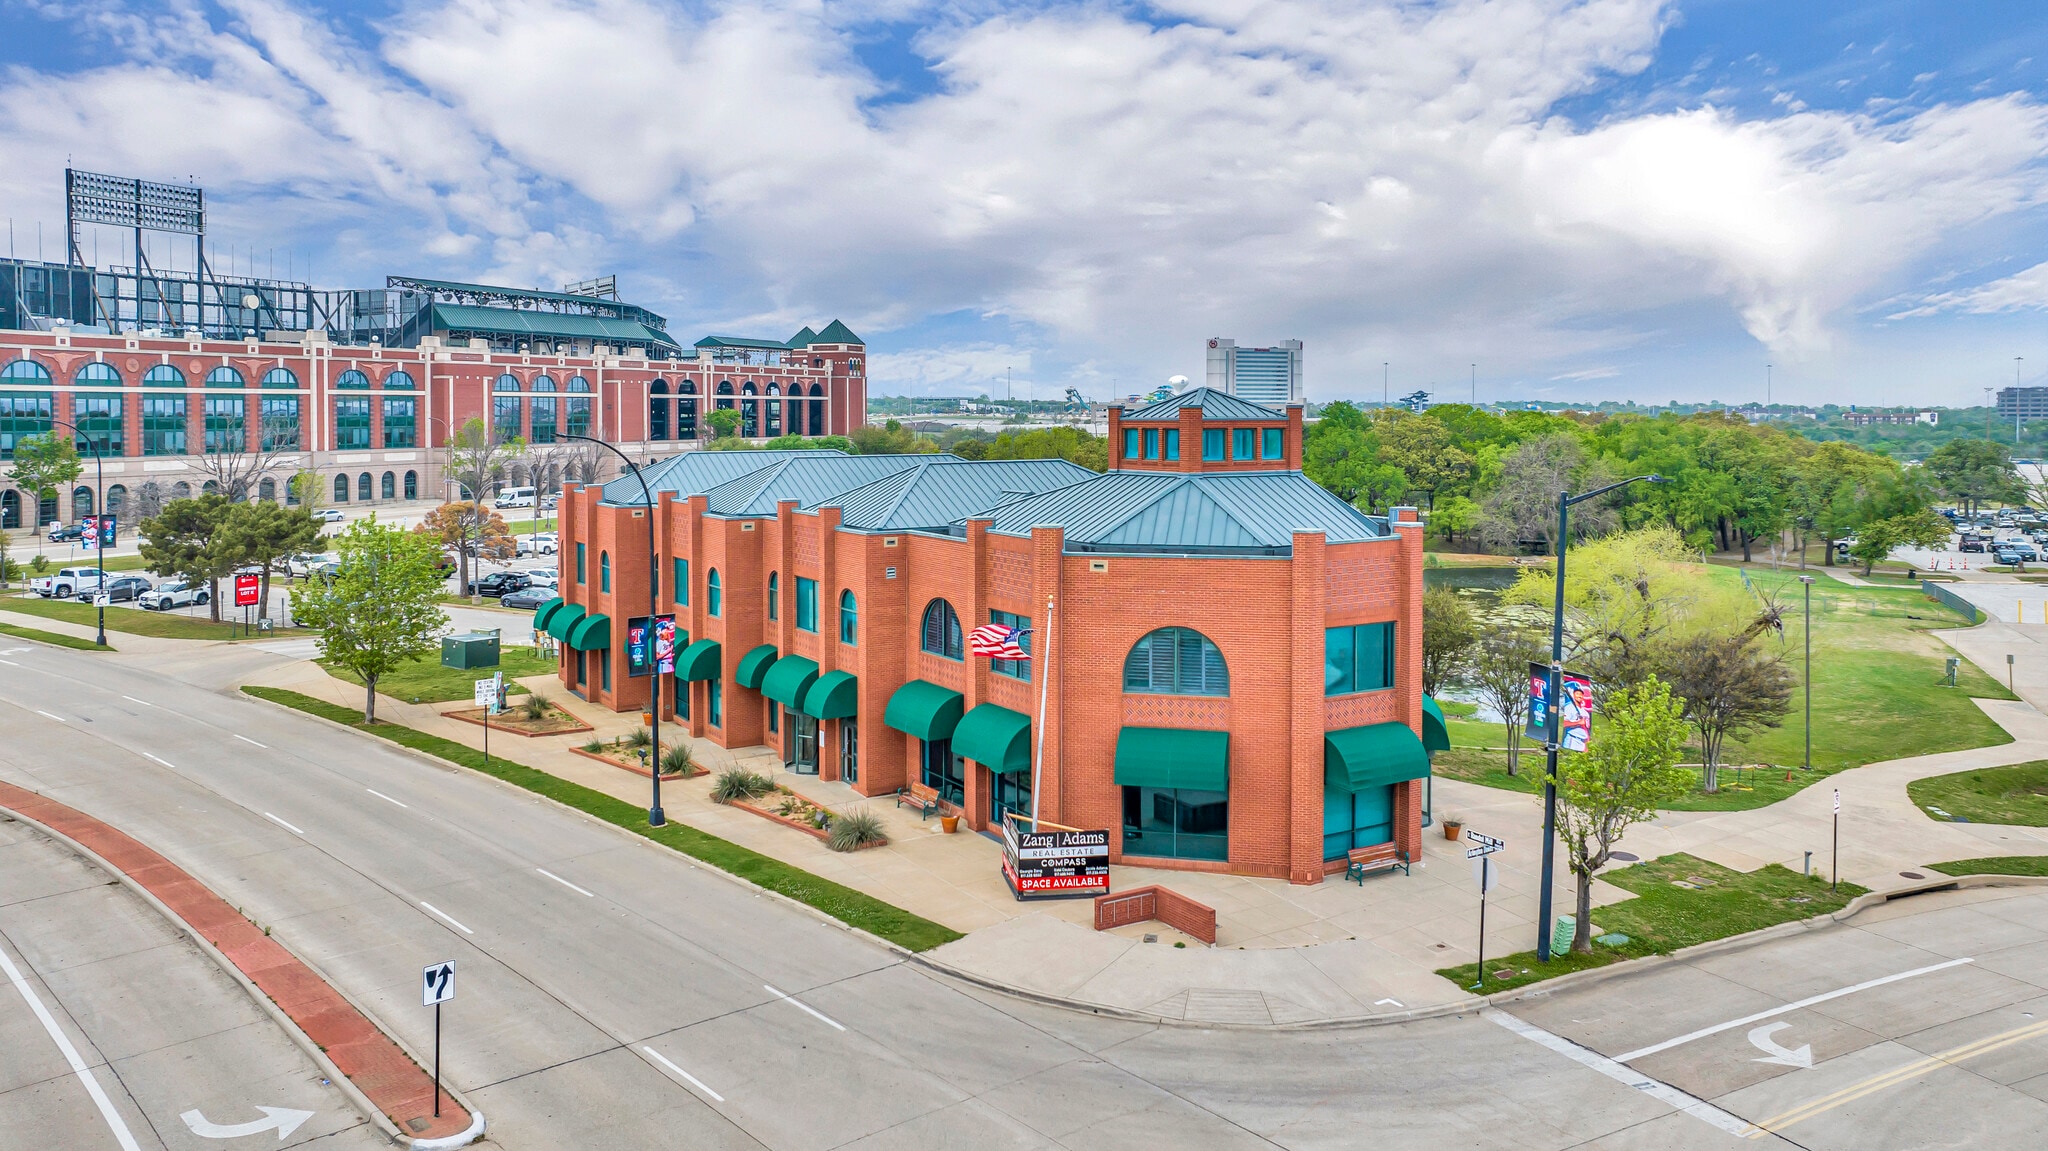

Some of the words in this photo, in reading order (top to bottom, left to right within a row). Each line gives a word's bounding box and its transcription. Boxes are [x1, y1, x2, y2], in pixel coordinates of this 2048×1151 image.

[262, 622, 269, 630] K
[631, 628, 645, 645] T
[1533, 678, 1547, 700] T
[1022, 833, 1054, 848] Zang
[1061, 831, 1105, 845] Adams
[1032, 849, 1056, 857] REAL
[1060, 847, 1095, 856] ESTATE
[1041, 858, 1087, 868] COMPASS
[1022, 879, 1051, 889] SPACE
[1053, 877, 1103, 887] AVAILABLE
